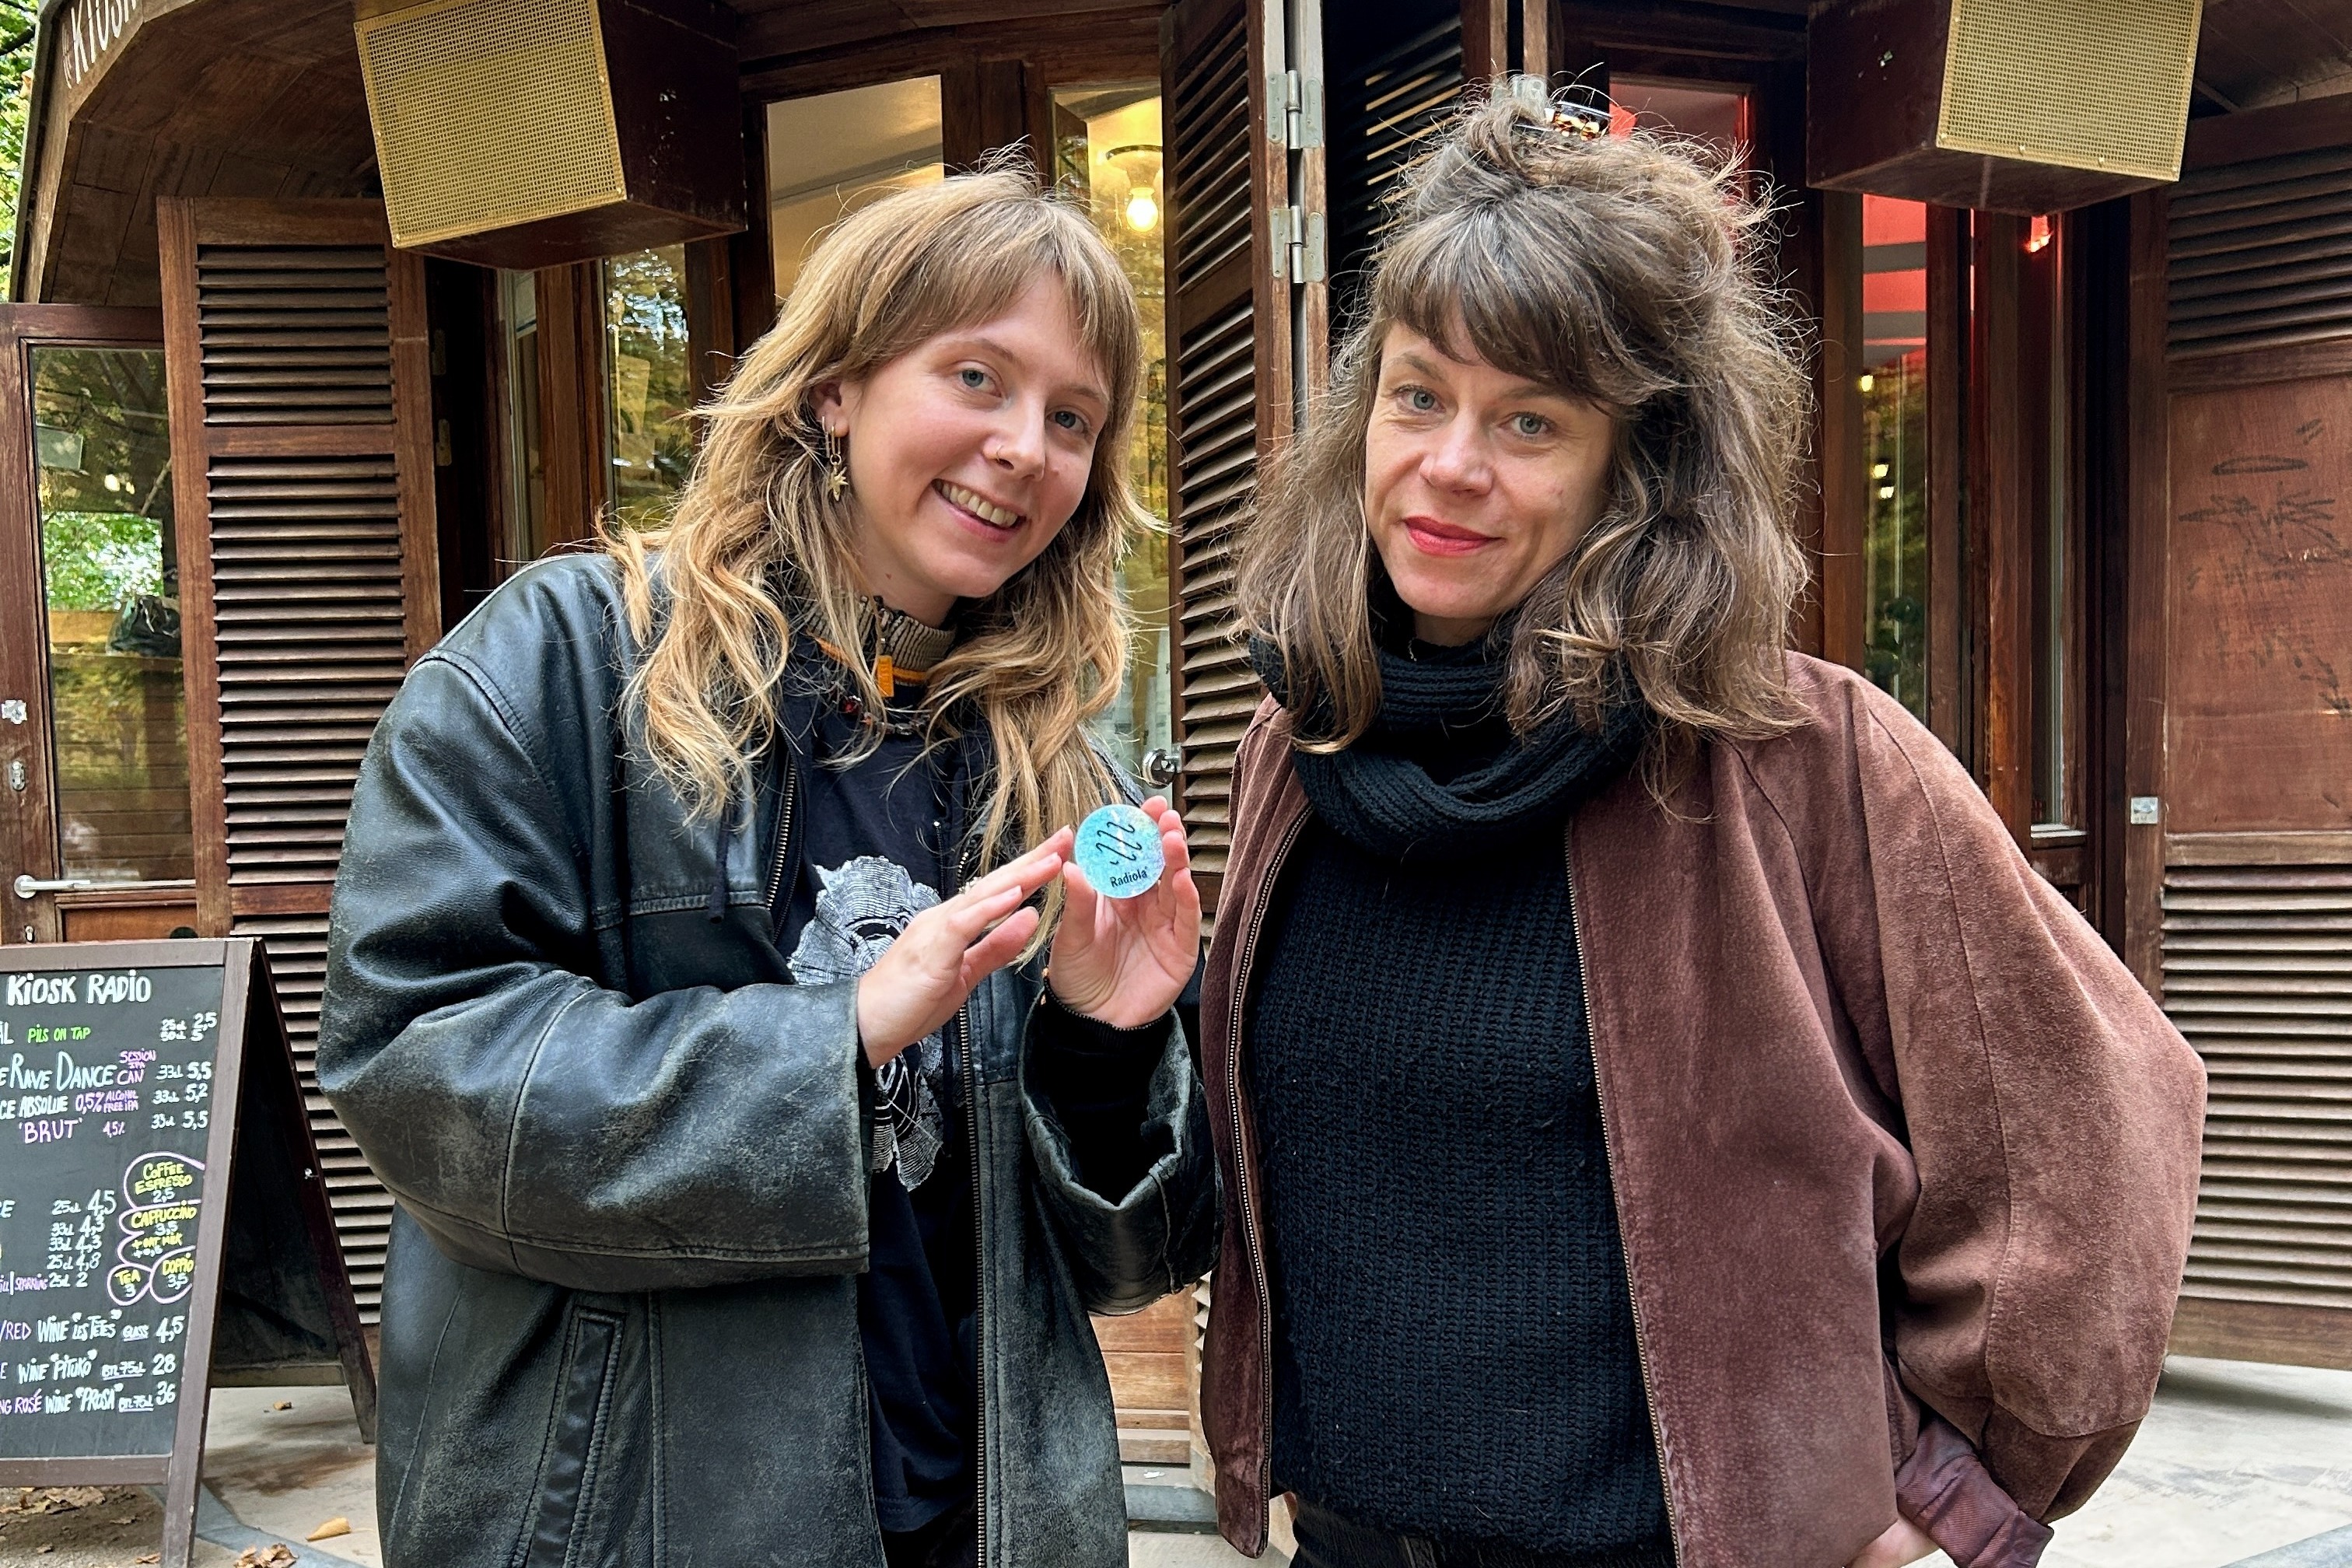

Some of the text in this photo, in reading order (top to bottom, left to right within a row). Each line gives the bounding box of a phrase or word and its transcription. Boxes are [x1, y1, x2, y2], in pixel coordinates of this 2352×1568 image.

[1110, 868, 1147, 887] Radiola
[193, 1011, 218, 1031] 2,5
[54, 1027, 67, 1041] ON
[71, 1027, 92, 1041] TAP
[190, 1028, 204, 1042] 5
[117, 1069, 145, 1085] CAN
[187, 1061, 212, 1081] 5,5
[75, 1091, 105, 1115] 0,5%
[184, 1083, 208, 1104] 5,2
[181, 1110, 208, 1131] 5,5
[135, 1174, 193, 1195] ESPRESSO
[152, 1187, 176, 1203] 2,5
[154, 1220, 179, 1237] 3,5
[75, 1271, 88, 1288] 2
[114, 1269, 141, 1285] TEA
[167, 1272, 189, 1290] 3,5
[124, 1283, 136, 1297] 3
[156, 1316, 185, 1343] 4,5
[152, 1353, 177, 1376] 28
[156, 1381, 176, 1405] 36
